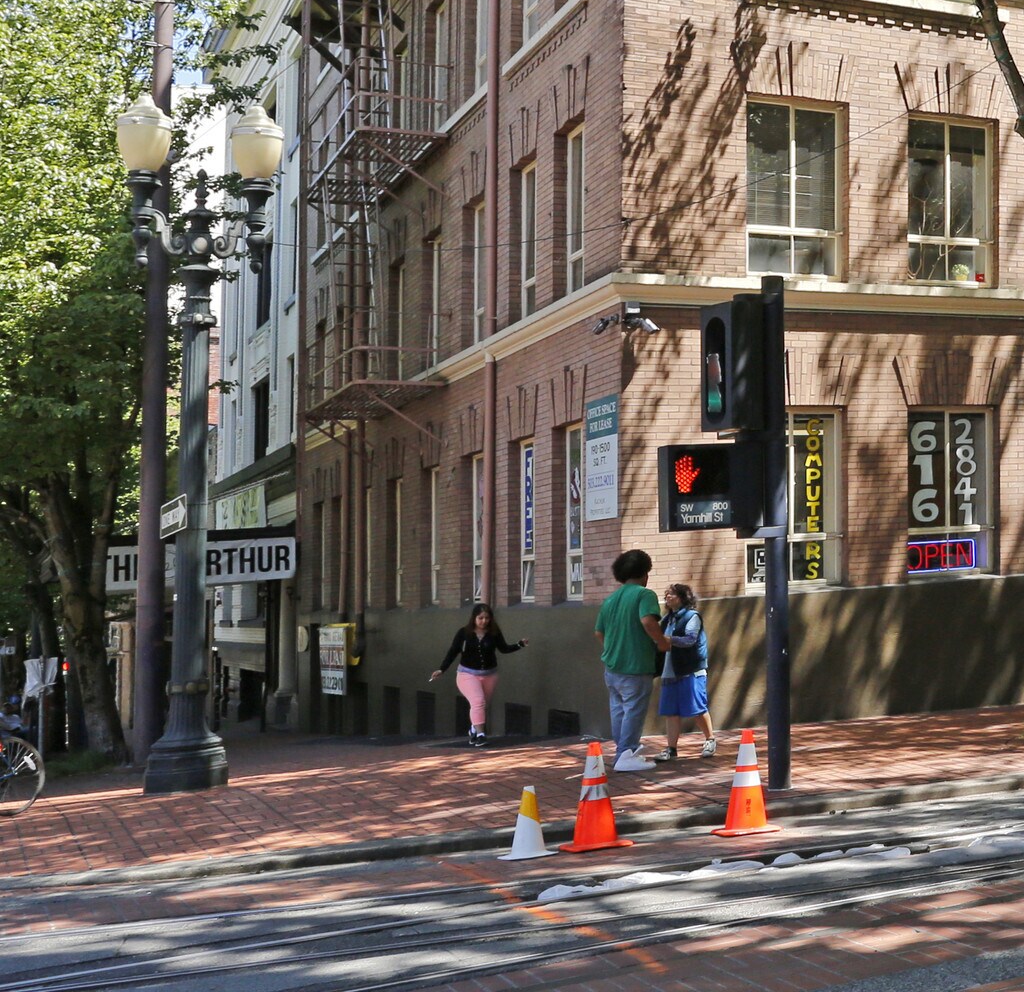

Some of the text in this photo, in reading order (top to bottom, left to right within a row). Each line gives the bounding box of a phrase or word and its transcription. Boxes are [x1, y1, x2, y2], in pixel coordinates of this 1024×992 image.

[587, 401, 617, 419] OFFICE SPACE
[589, 417, 613, 433] FOR LEASE
[954, 418, 977, 525] 2841
[680, 502, 728, 513] SW 800
[805, 418, 823, 580] COMPUTERS
[681, 512, 724, 524] Yamhill St
[206, 544, 290, 576] RTHUR
[907, 543, 972, 570] OPEN
